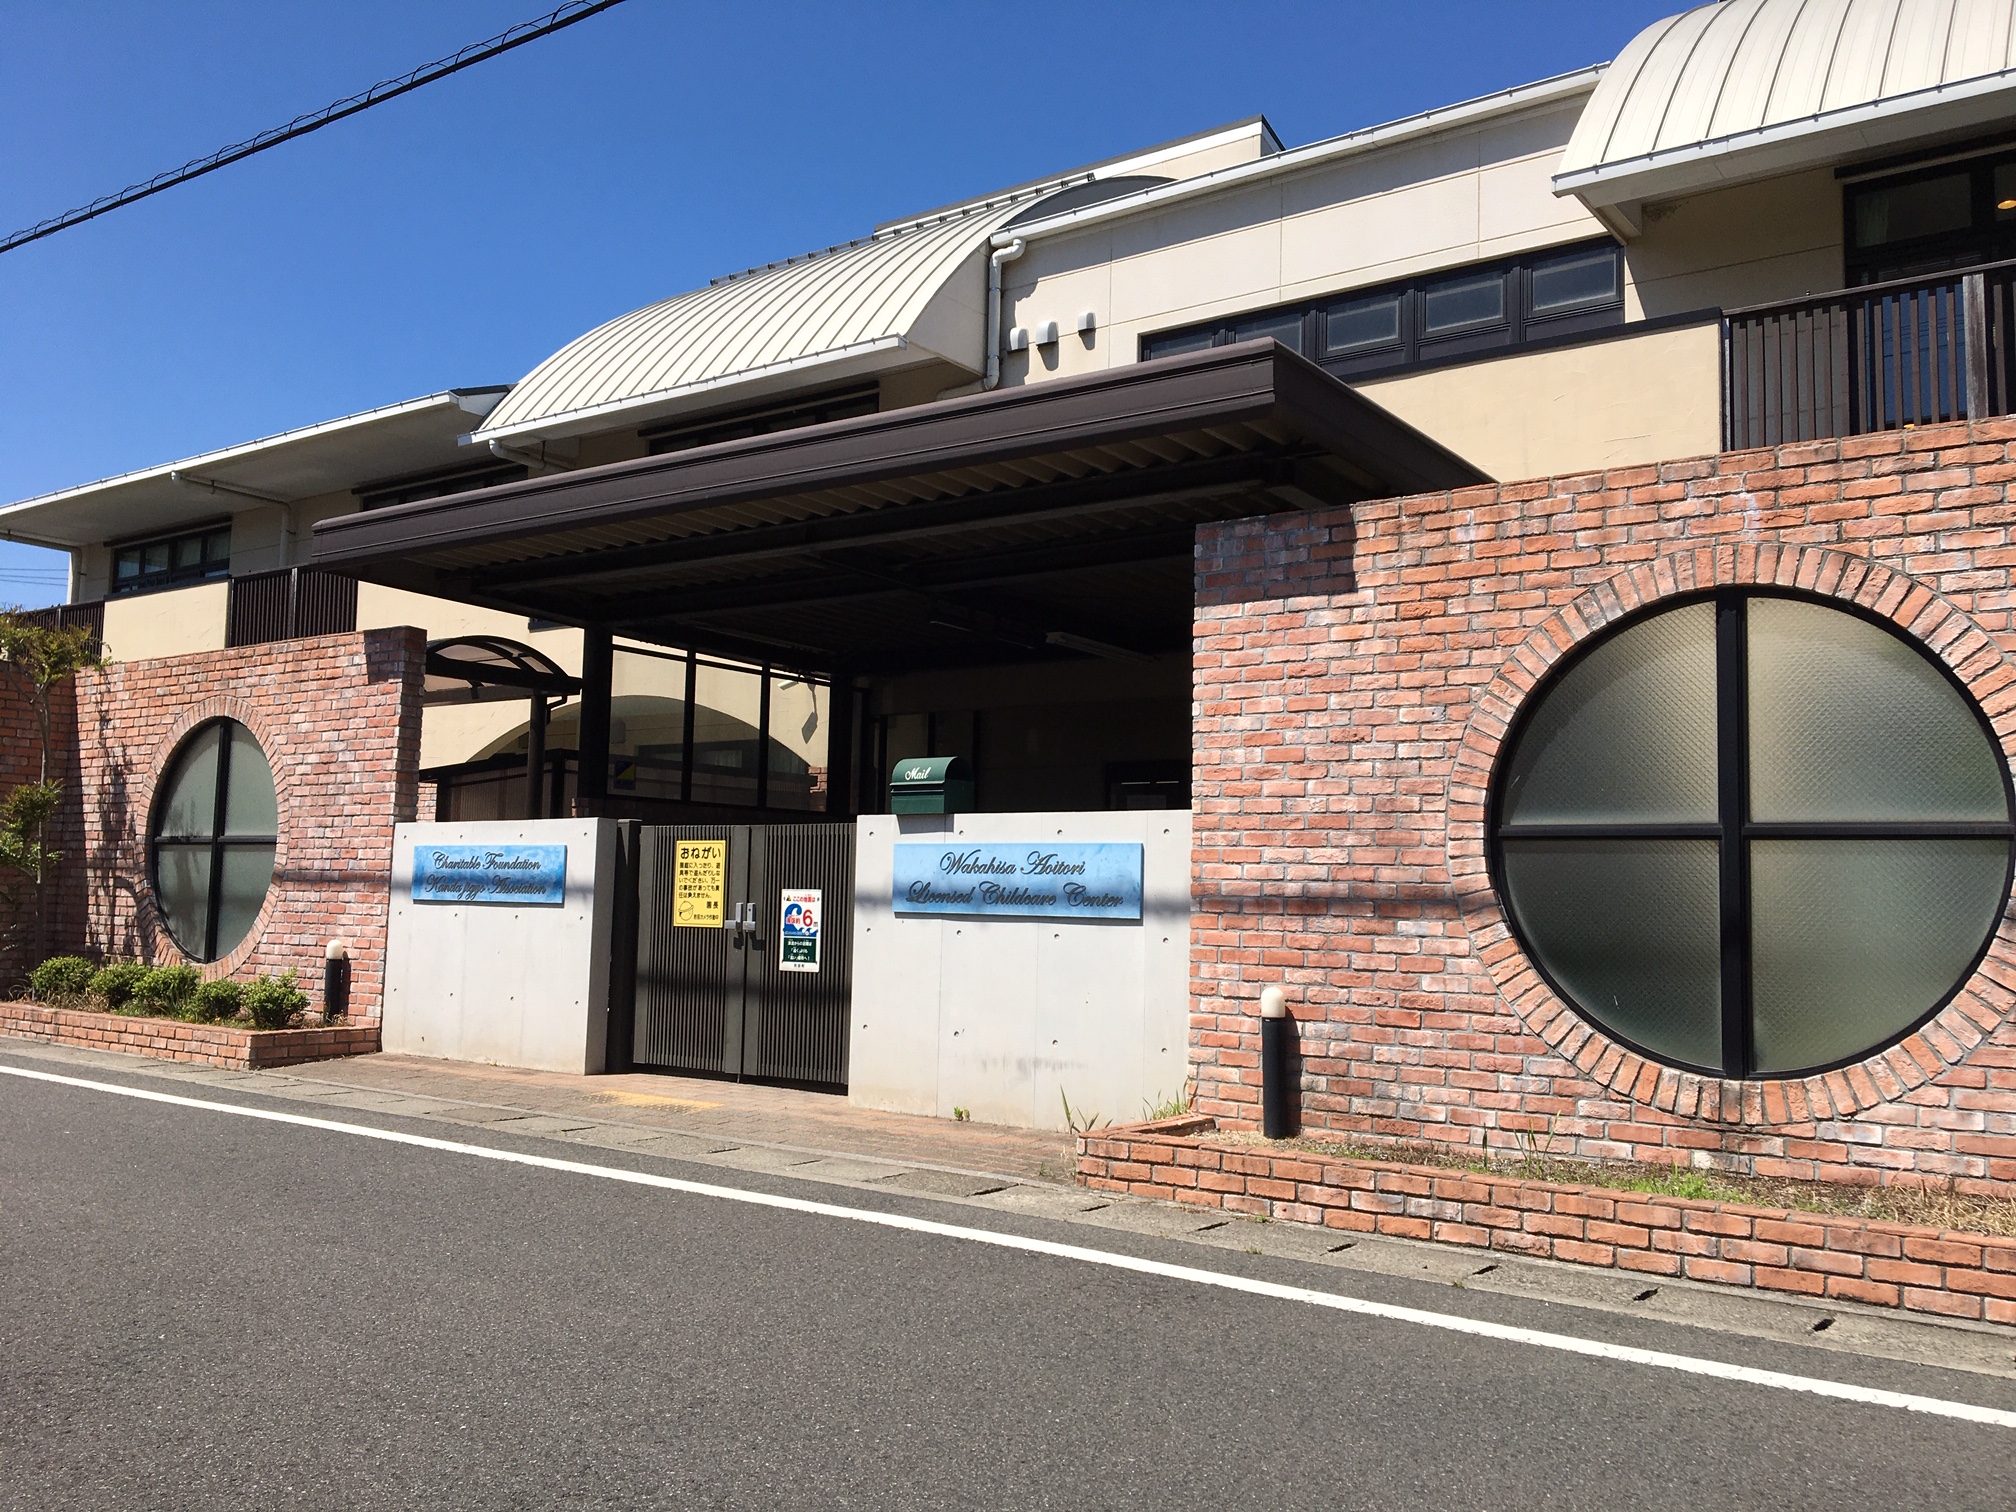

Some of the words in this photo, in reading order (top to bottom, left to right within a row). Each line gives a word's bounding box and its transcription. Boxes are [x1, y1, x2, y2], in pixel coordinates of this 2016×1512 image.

[904, 766, 932, 781] Mail
[432, 851, 482, 870] Charitable
[482, 852, 541, 870] Foundation
[680, 846, 721, 859] おねがい
[939, 849, 1016, 875] Wakahisa
[1020, 850, 1086, 875] Aoitori
[425, 874, 462, 893] Kanda
[488, 875, 547, 895] Association
[906, 880, 976, 904] Licensed
[978, 881, 1057, 906] Childcare
[1063, 882, 1124, 908] Center
[802, 909, 813, 927] 6
